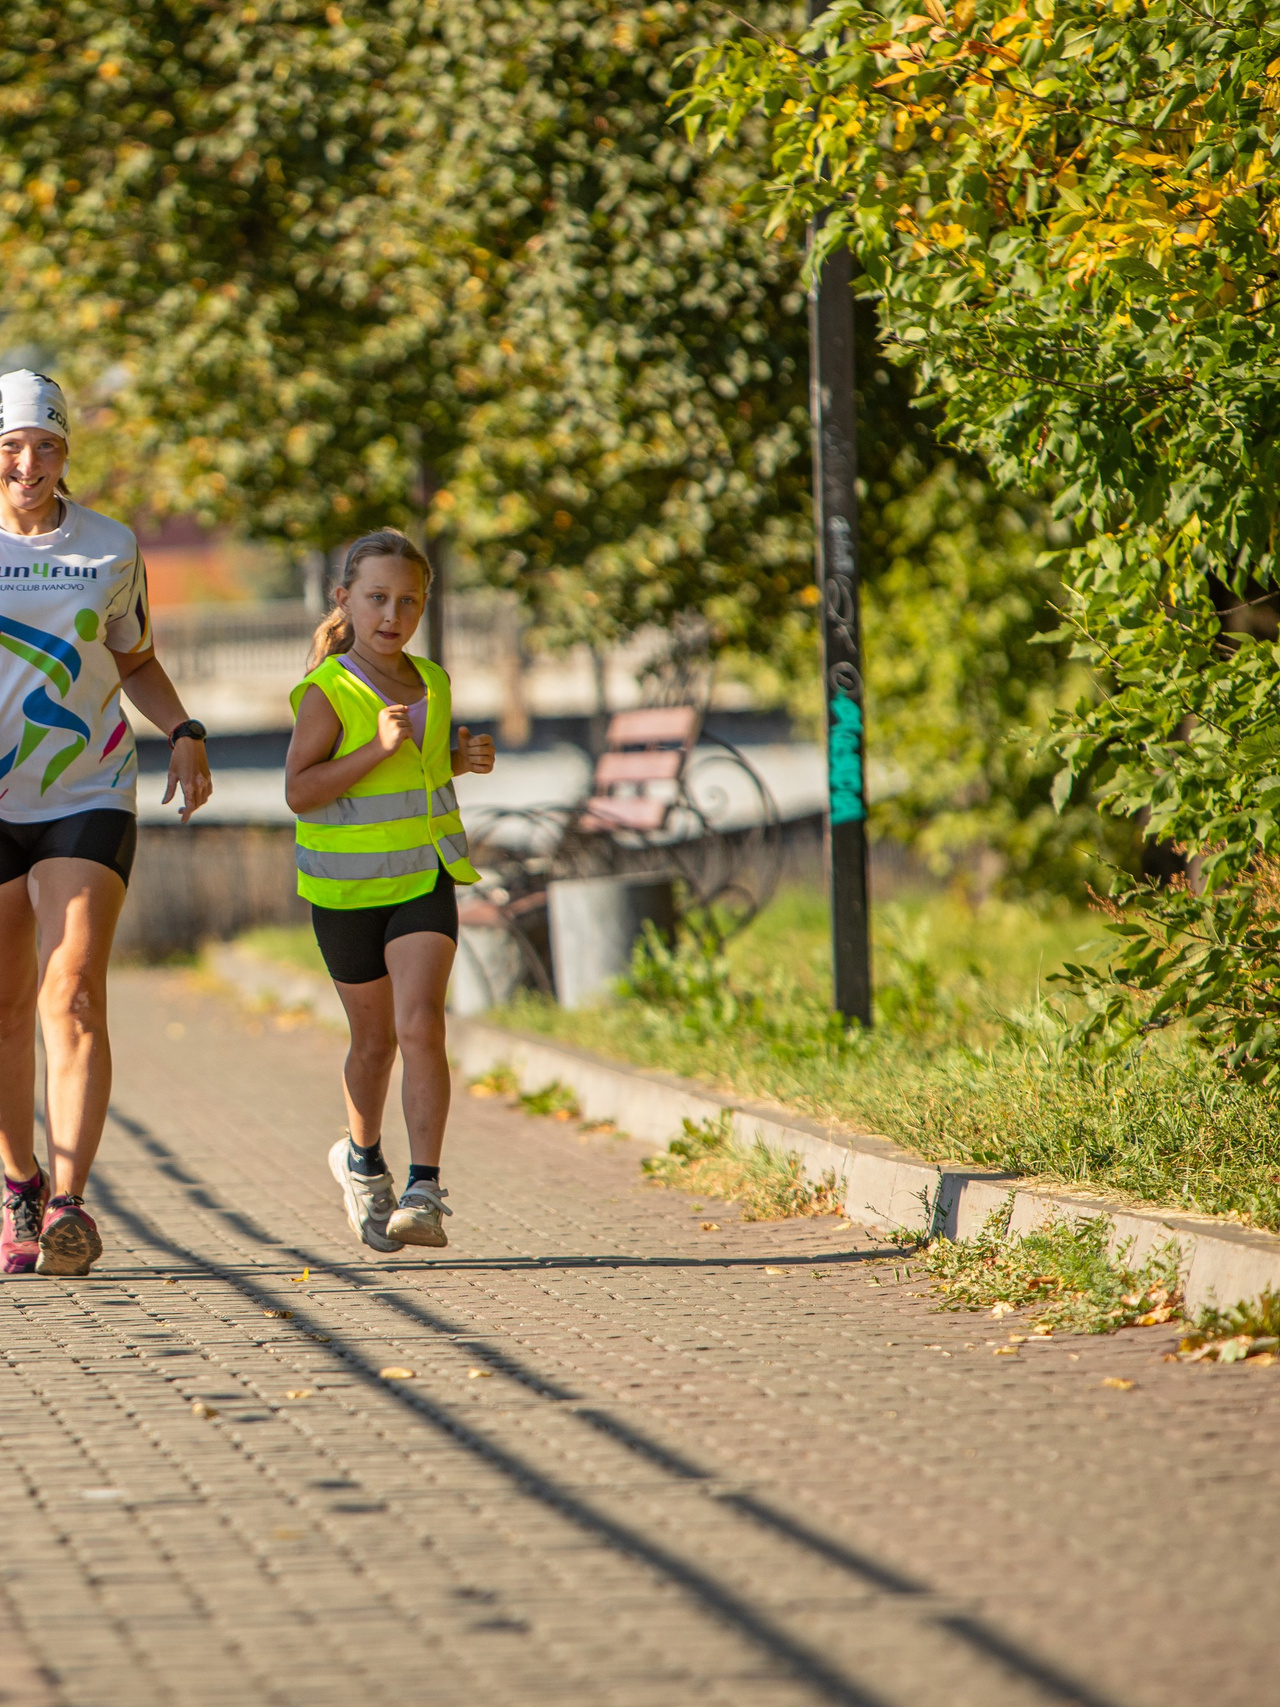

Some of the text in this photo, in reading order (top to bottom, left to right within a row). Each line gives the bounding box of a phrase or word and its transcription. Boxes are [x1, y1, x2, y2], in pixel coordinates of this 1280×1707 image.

[47, 407, 68, 433] 202
[16, 584, 40, 592] CLUB
[42, 583, 85, 591] IVANOVO
